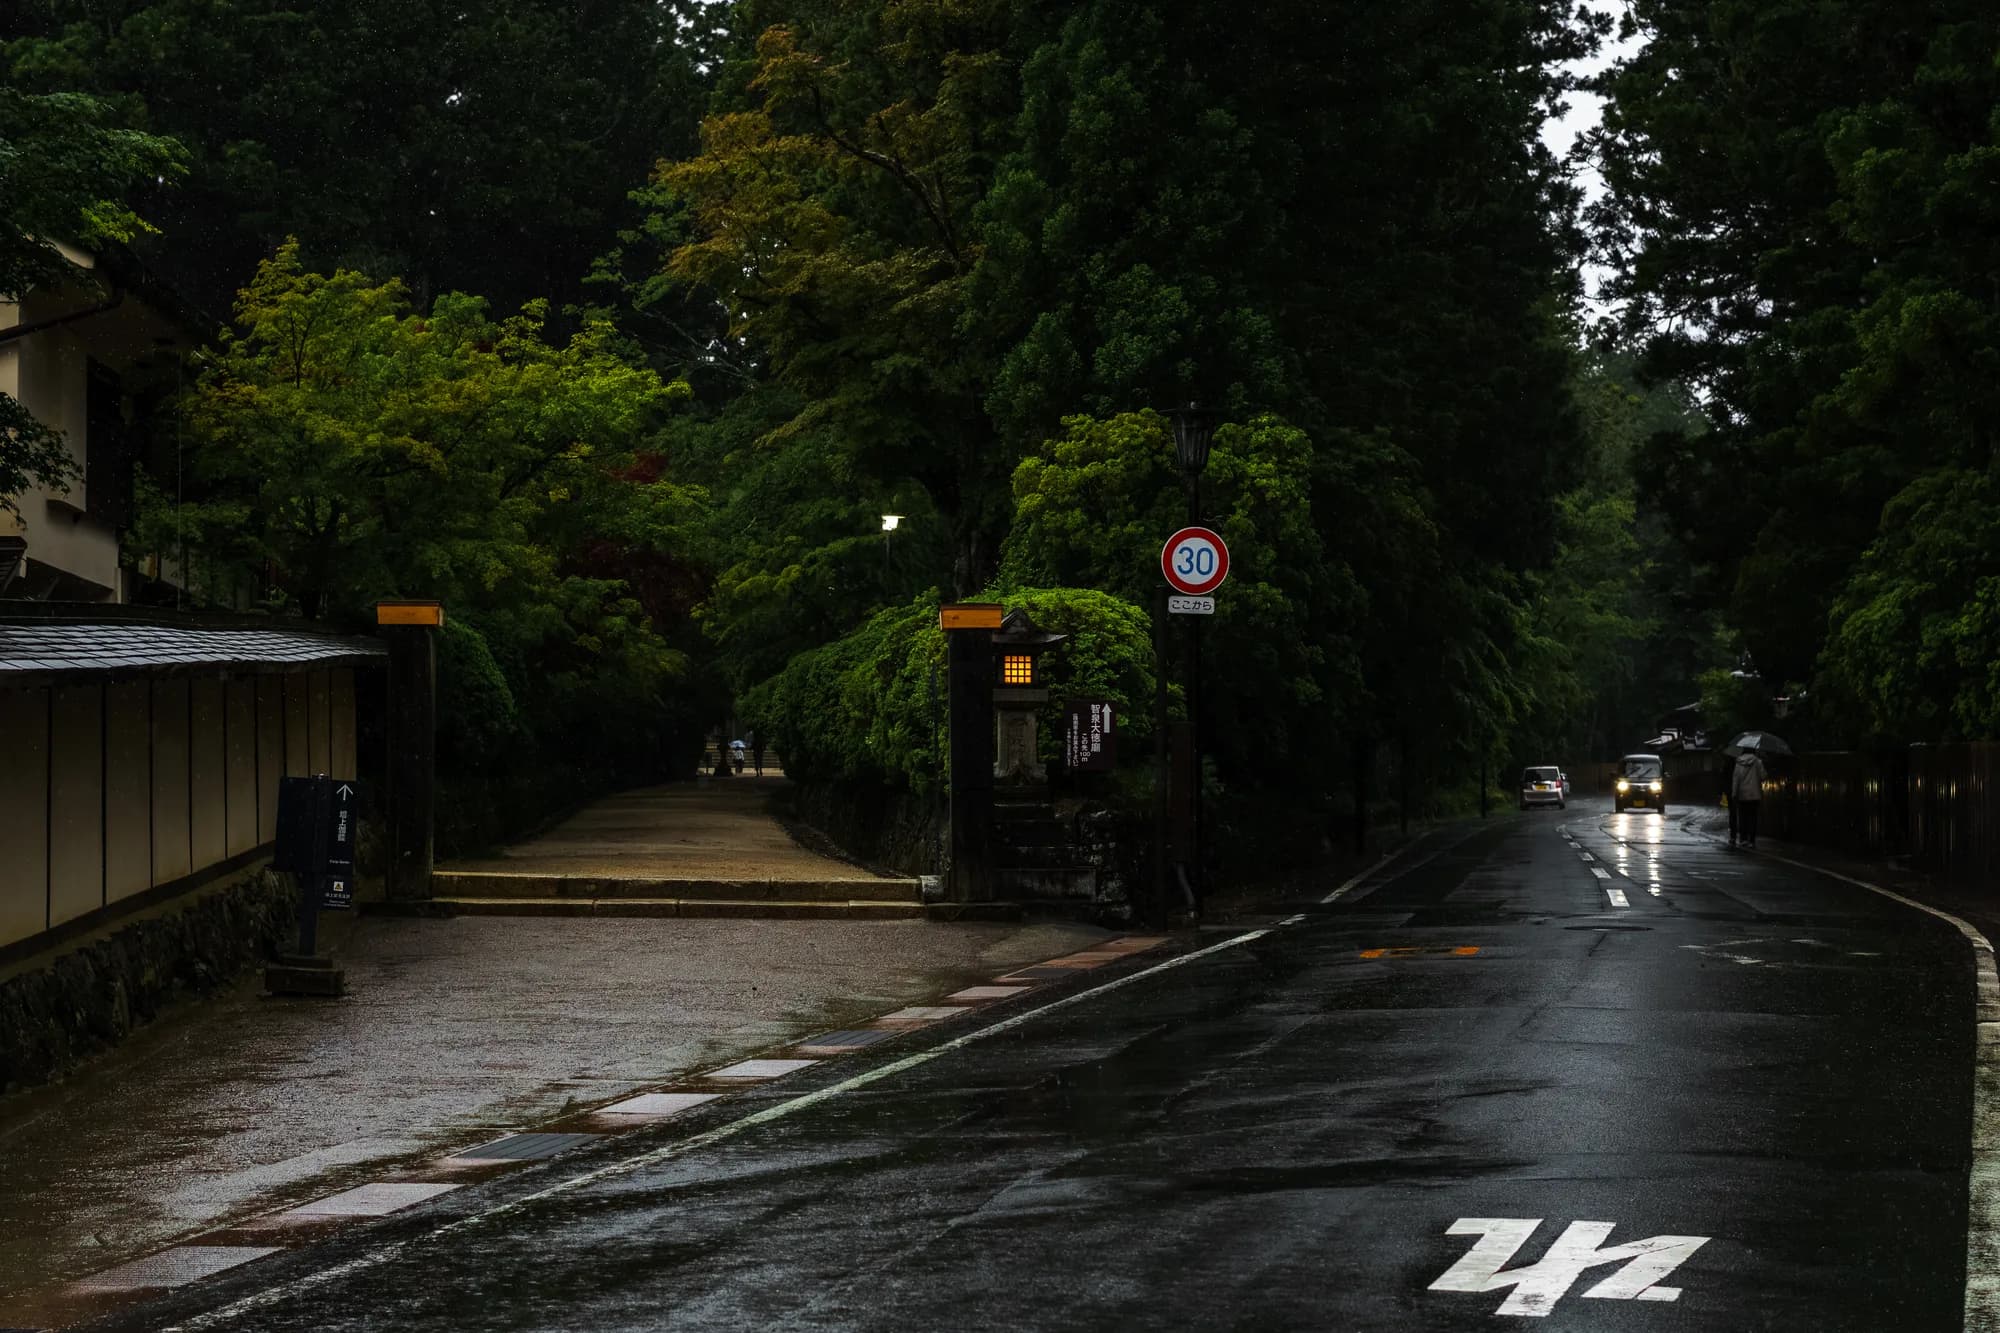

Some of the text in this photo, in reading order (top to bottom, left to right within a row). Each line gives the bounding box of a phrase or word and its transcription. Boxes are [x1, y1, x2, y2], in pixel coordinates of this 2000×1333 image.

[1177, 547, 1214, 575] 30
[1171, 599, 1212, 611] ここから
[1090, 704, 1101, 753] 智泉大徳廟
